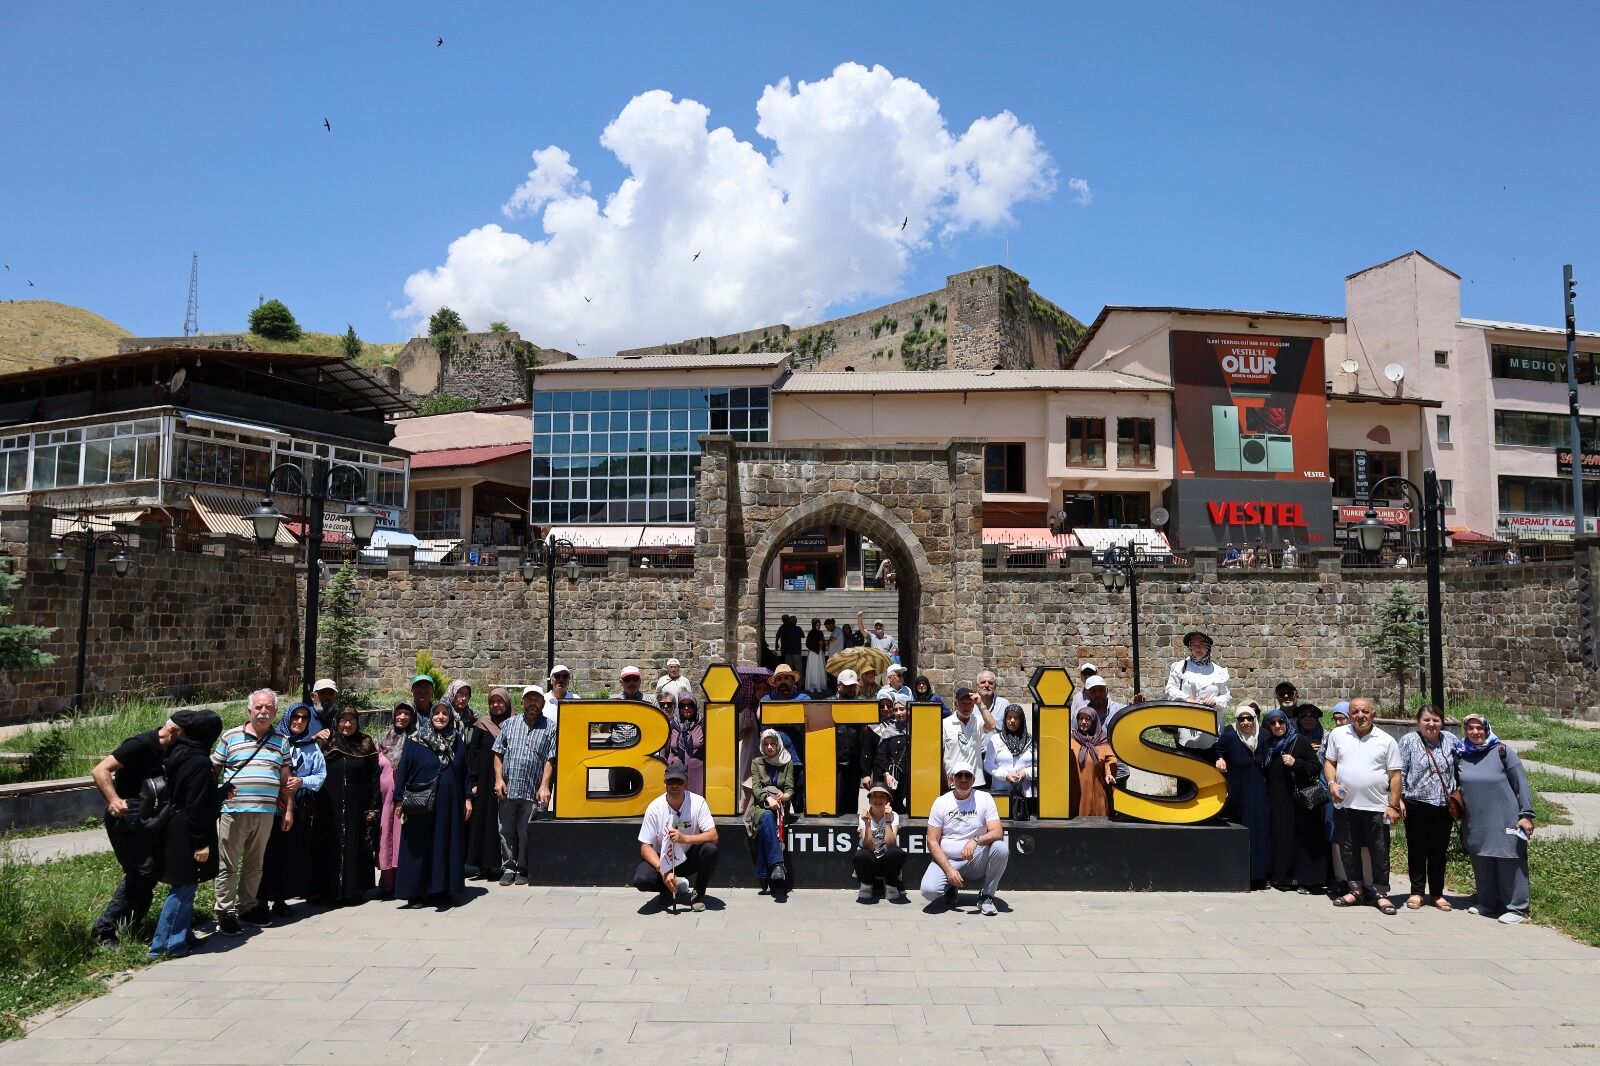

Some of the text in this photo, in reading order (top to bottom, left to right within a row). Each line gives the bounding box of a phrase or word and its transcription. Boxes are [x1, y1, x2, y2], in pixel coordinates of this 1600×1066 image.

[1222, 355, 1276, 374] OLUR
[1303, 470, 1326, 478] VESTEL
[1208, 502, 1309, 527] VESTEL
[1342, 509, 1366, 517] TURKIS
[1511, 517, 1576, 527] MERMUT KASA
[555, 662, 1229, 825] BİTLİS
[780, 828, 852, 853] İTLİS
